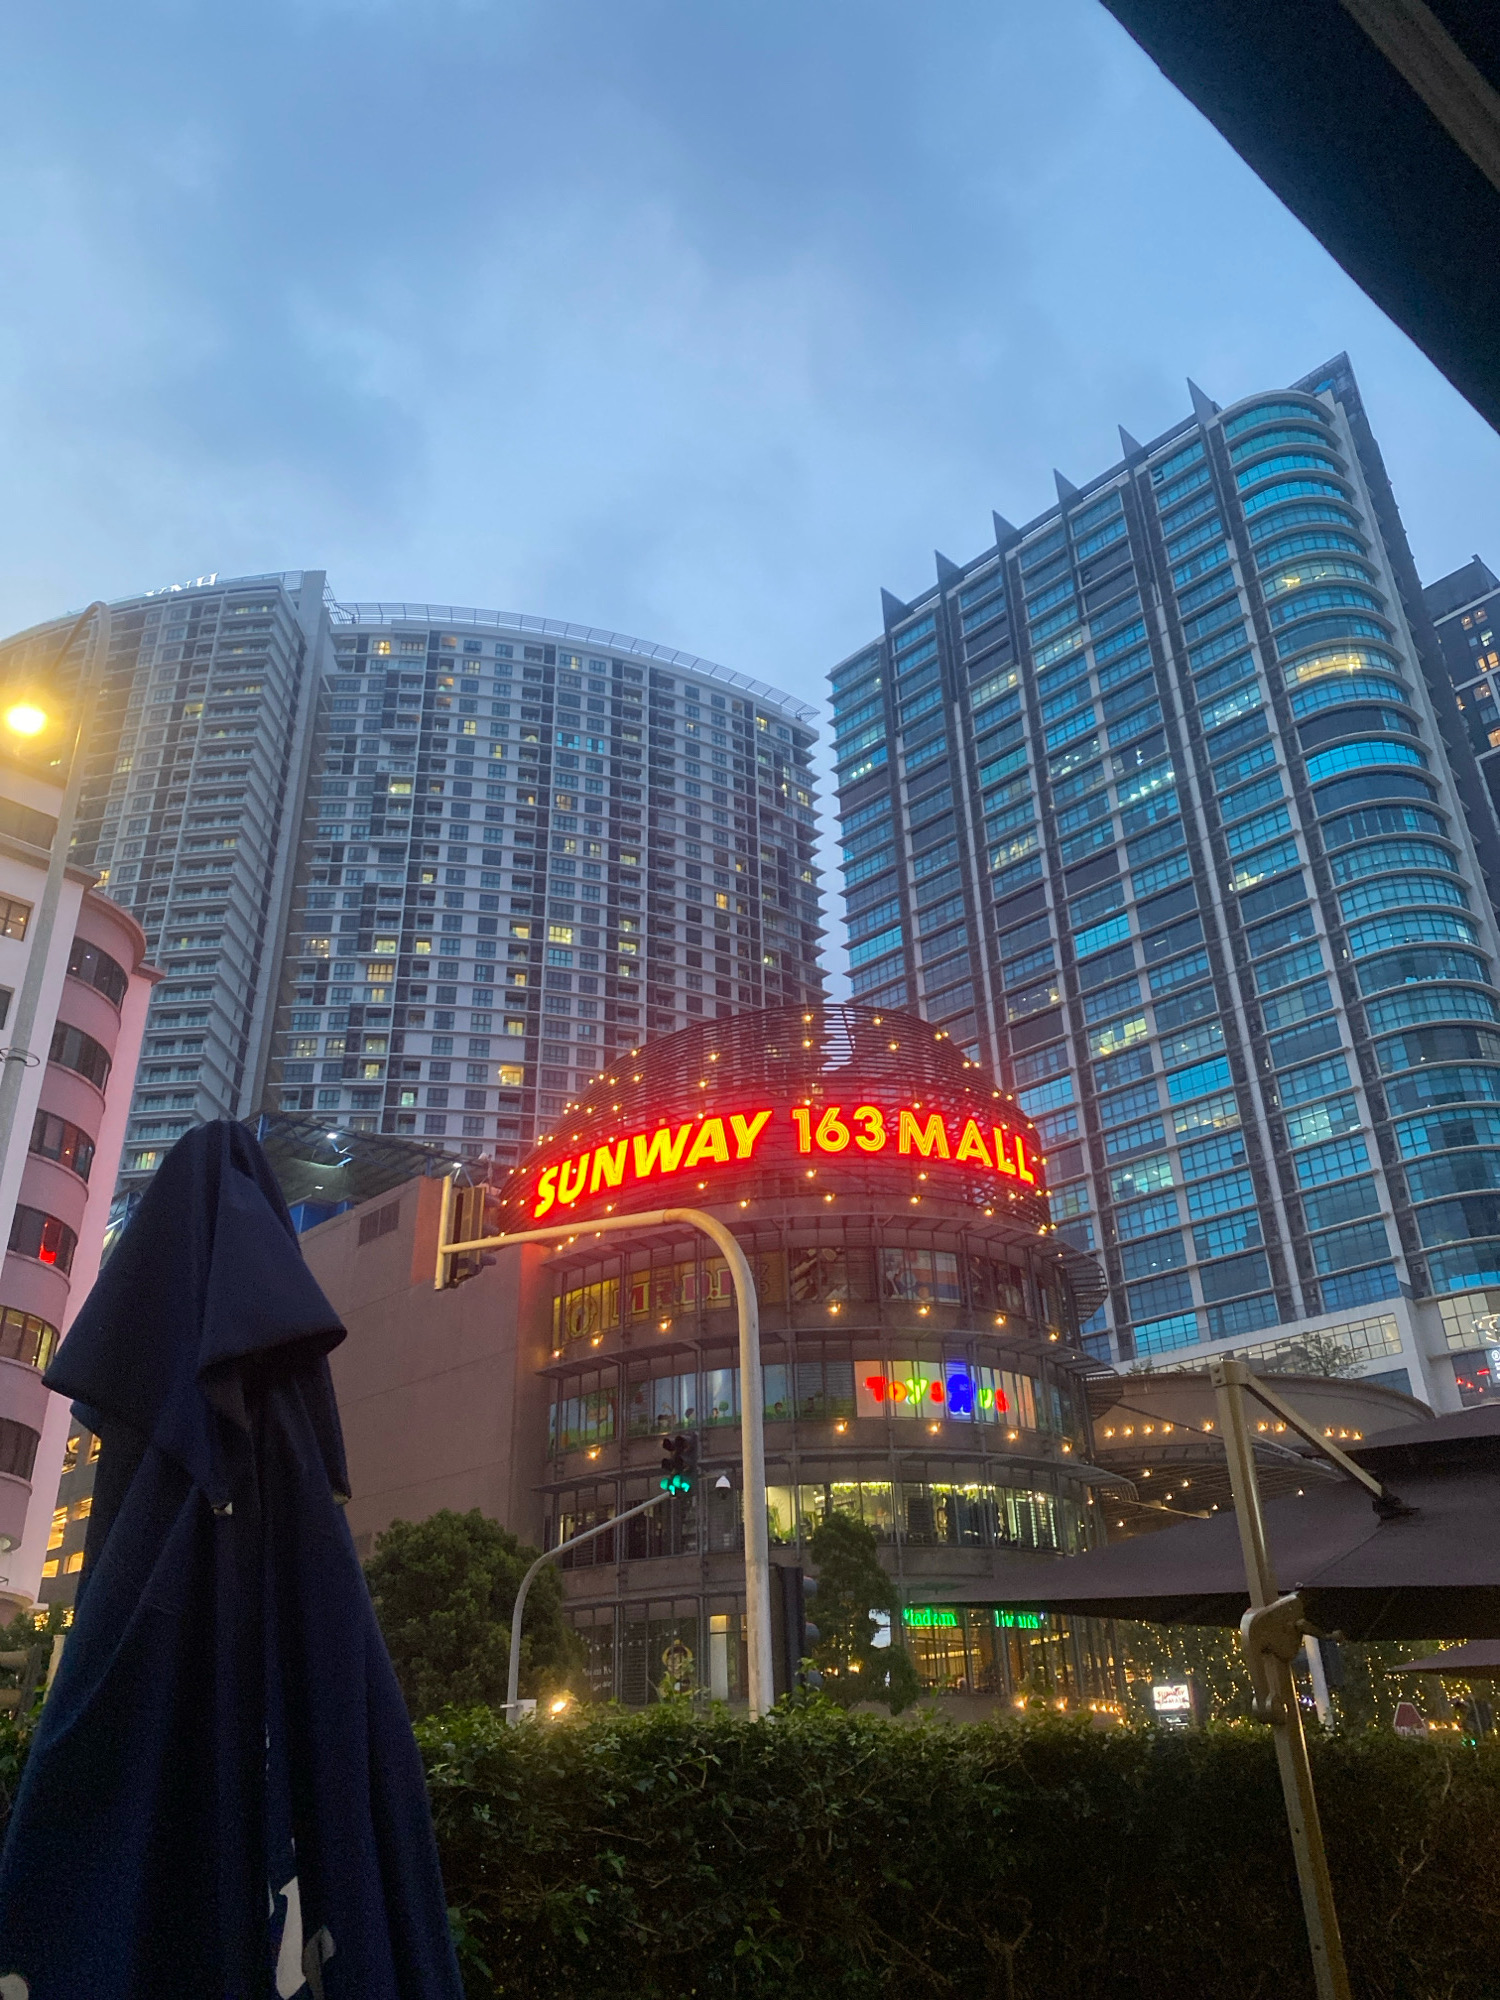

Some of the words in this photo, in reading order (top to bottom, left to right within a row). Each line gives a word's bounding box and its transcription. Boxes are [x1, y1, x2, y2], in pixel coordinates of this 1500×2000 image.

[533, 1109, 773, 1219] SUNWAY
[792, 1106, 887, 1154] 163
[898, 1109, 1035, 1186] MALL
